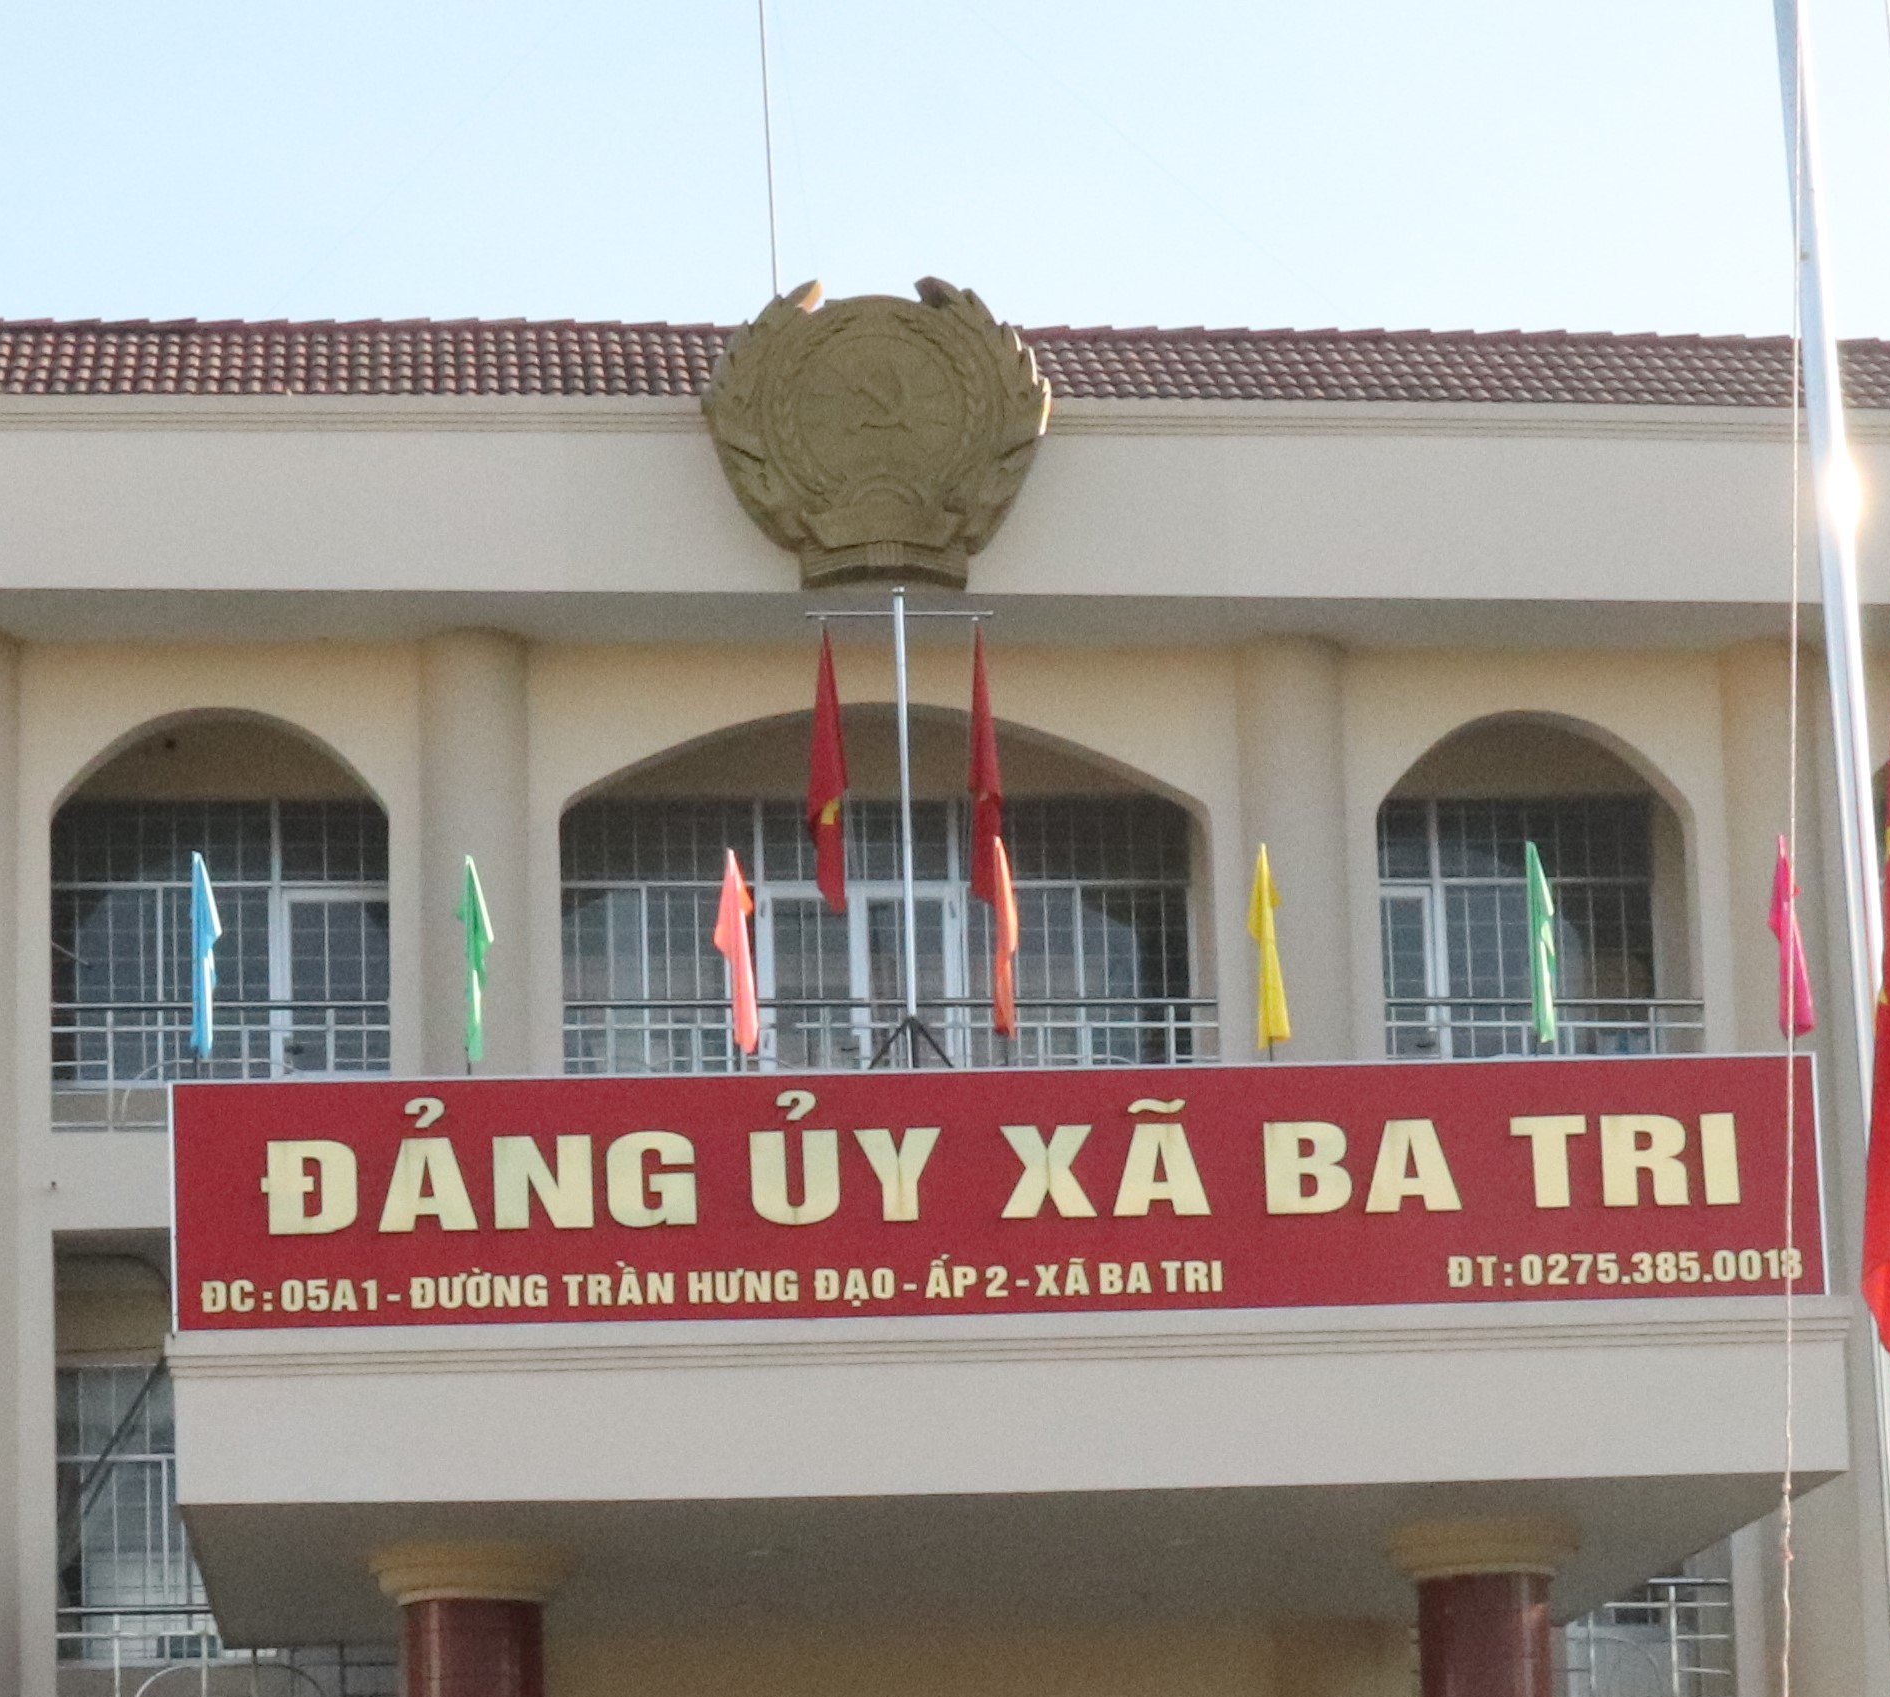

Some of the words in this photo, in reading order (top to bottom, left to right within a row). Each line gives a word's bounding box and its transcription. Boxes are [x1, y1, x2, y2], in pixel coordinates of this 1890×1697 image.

[260, 1096, 699, 1236] ĐẢNG
[749, 1088, 942, 1226] ỦY
[999, 1097, 1213, 1219] XÃ
[1261, 1118, 1464, 1215] BA
[1509, 1112, 1742, 1208] TRI
[561, 1260, 675, 1307] TRẦN
[687, 1267, 799, 1304] HƯNG
[1098, 1261, 1152, 1295] BA
[1160, 1260, 1224, 1293] TRI
